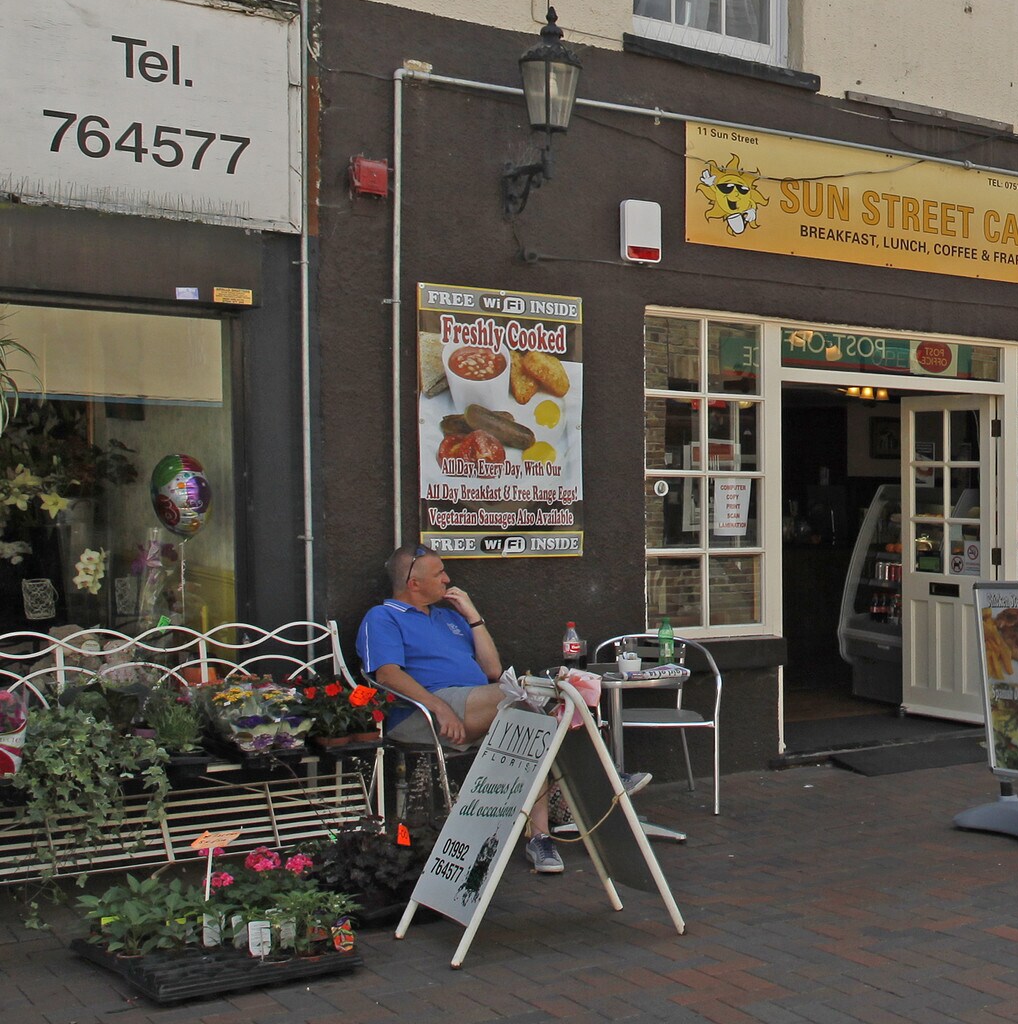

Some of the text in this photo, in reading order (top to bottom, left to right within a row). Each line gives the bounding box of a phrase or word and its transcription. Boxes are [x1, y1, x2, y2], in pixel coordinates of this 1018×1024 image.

[111, 34, 194, 88] Tel.
[43, 109, 251, 175] 764577
[697, 126, 759, 145] 11 Sun Street
[987, 177, 1003, 188] TEL:
[779, 176, 850, 222] SUN
[861, 189, 975, 239] STREET
[800, 224, 879, 249] BREAKFAST,
[883, 235, 931, 255] LUNCH,
[933, 243, 978, 260] COFFEE
[981, 249, 990, 262] &
[427, 290, 475, 307] FREE
[530, 300, 578, 317] INSIDE
[441, 315, 567, 354] Freshly Cooked
[441, 458, 562, 479] All Day, Every Day, With Our
[426, 483, 578, 504] All Day Breakfast & Free Range Eggs!
[428, 508, 574, 529] Vegetarian Sausages Also Available
[430, 537, 476, 552] FREE
[530, 537, 579, 550] INSIDE
[487, 719, 551, 759] LYNNES
[481, 750, 538, 774] FLORIST
[470, 775, 524, 800] Flowers for
[459, 798, 516, 818] all occasions
[442, 838, 470, 862] 01992
[430, 857, 465, 884] 764577
